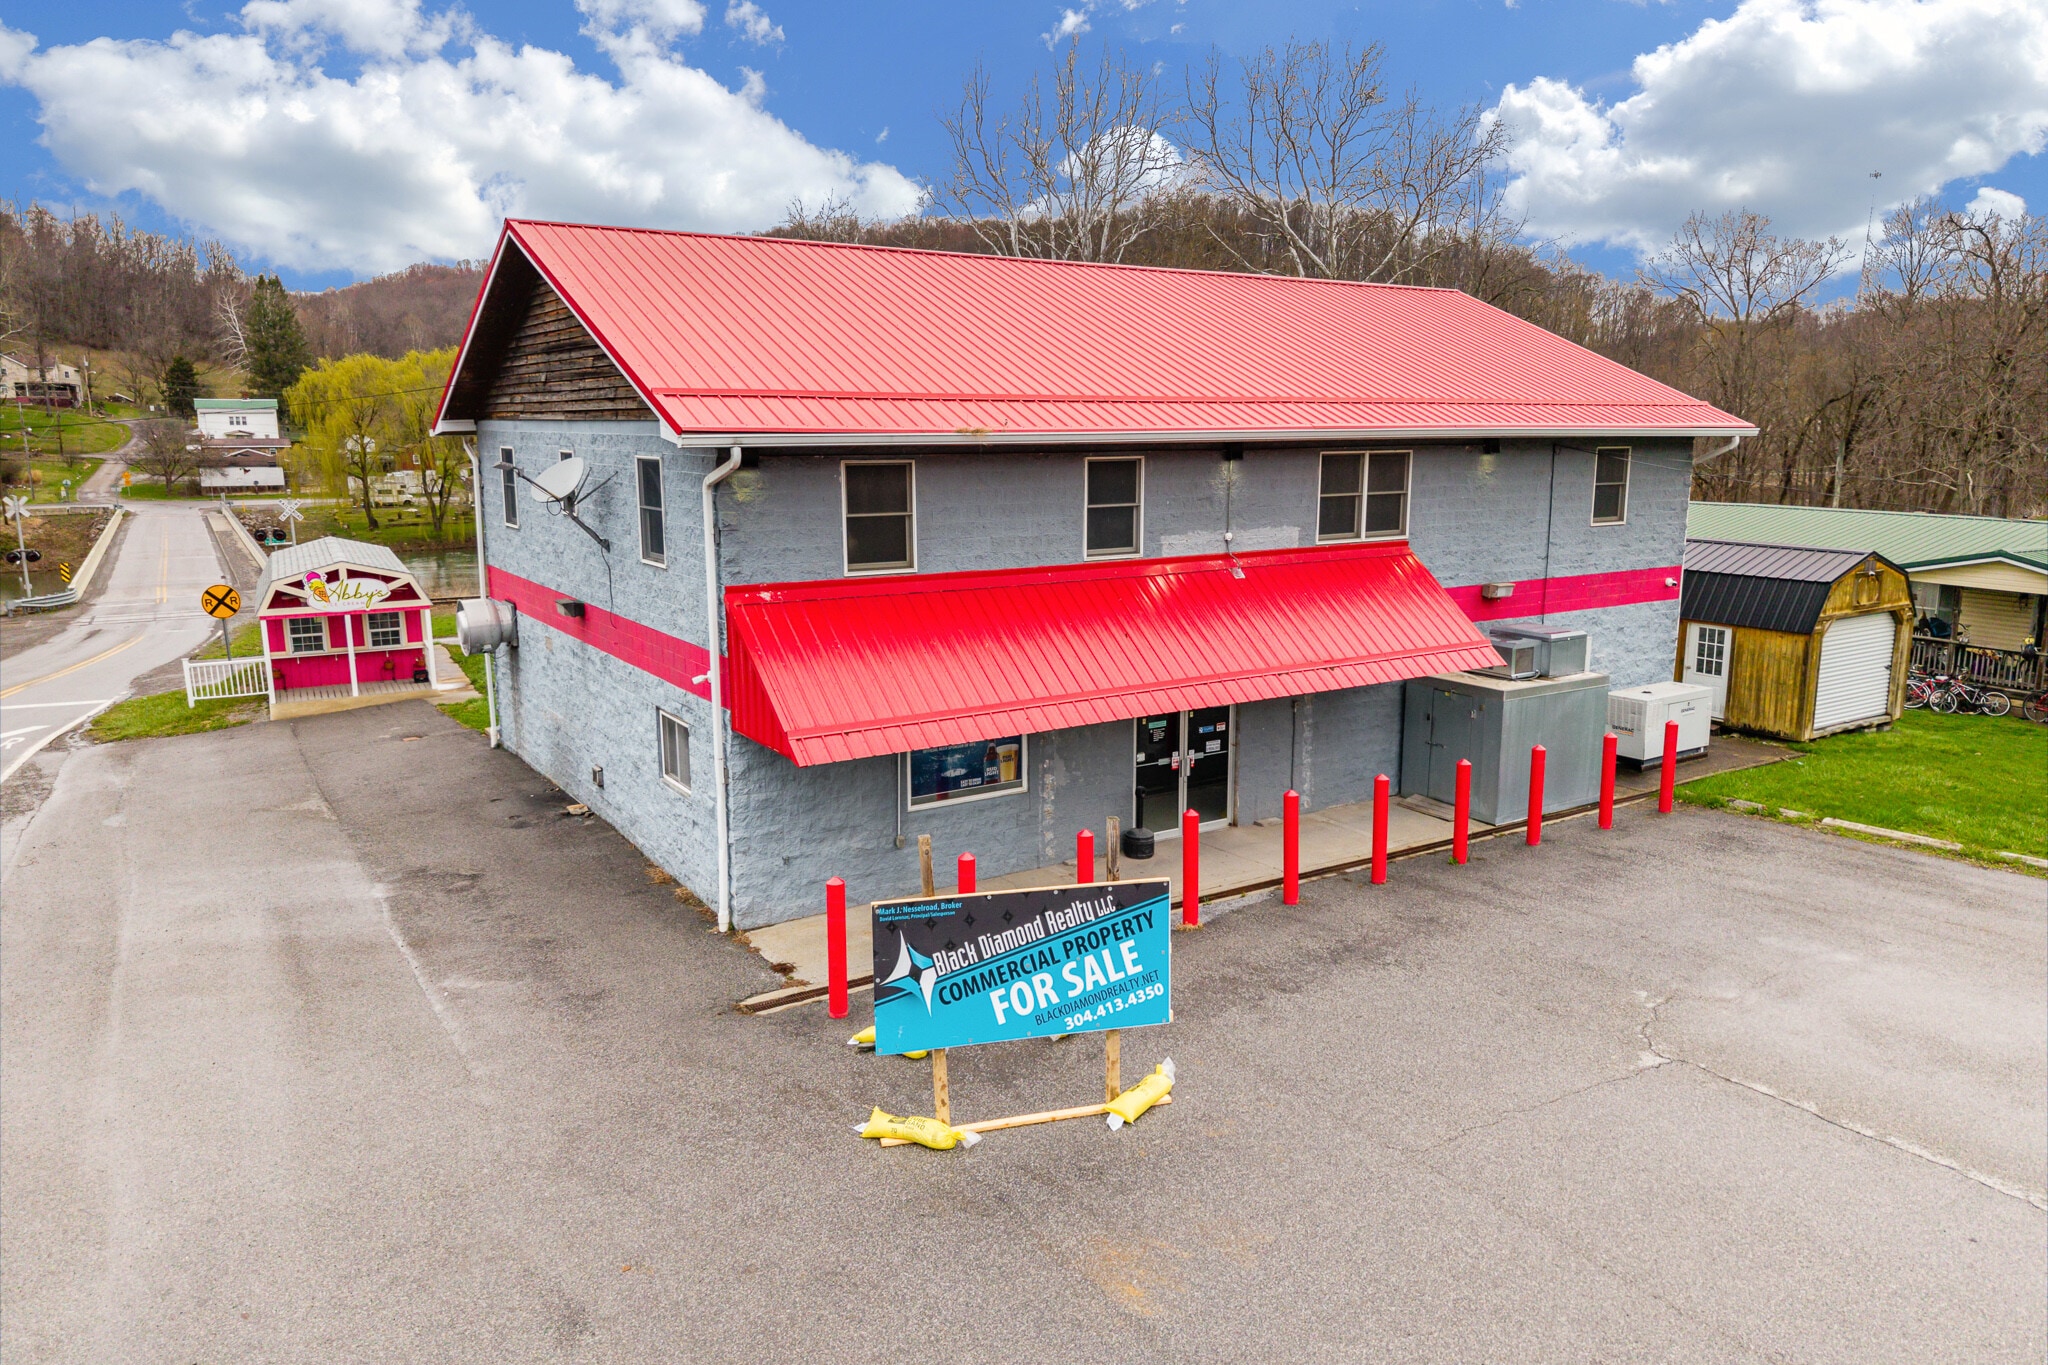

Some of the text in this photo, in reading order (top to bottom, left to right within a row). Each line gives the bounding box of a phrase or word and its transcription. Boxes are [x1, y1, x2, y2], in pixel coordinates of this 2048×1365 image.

[205, 596, 238, 607] R R
[327, 579, 389, 608] Abby's
[879, 907, 896, 915] Mark
[903, 903, 940, 914] Nesselroad,
[941, 901, 963, 910] Broker
[932, 895, 1117, 977] Black Diamond Realty LLC
[938, 909, 1154, 1005] COMMERCIAL PROPERTY
[989, 939, 1143, 1025] FOR SALE
[1035, 970, 1160, 1026] BLACKDIAMONDREALTY.NET
[1064, 982, 1165, 1031] 304.413.4350
[907, 1120, 925, 1129] SAND
